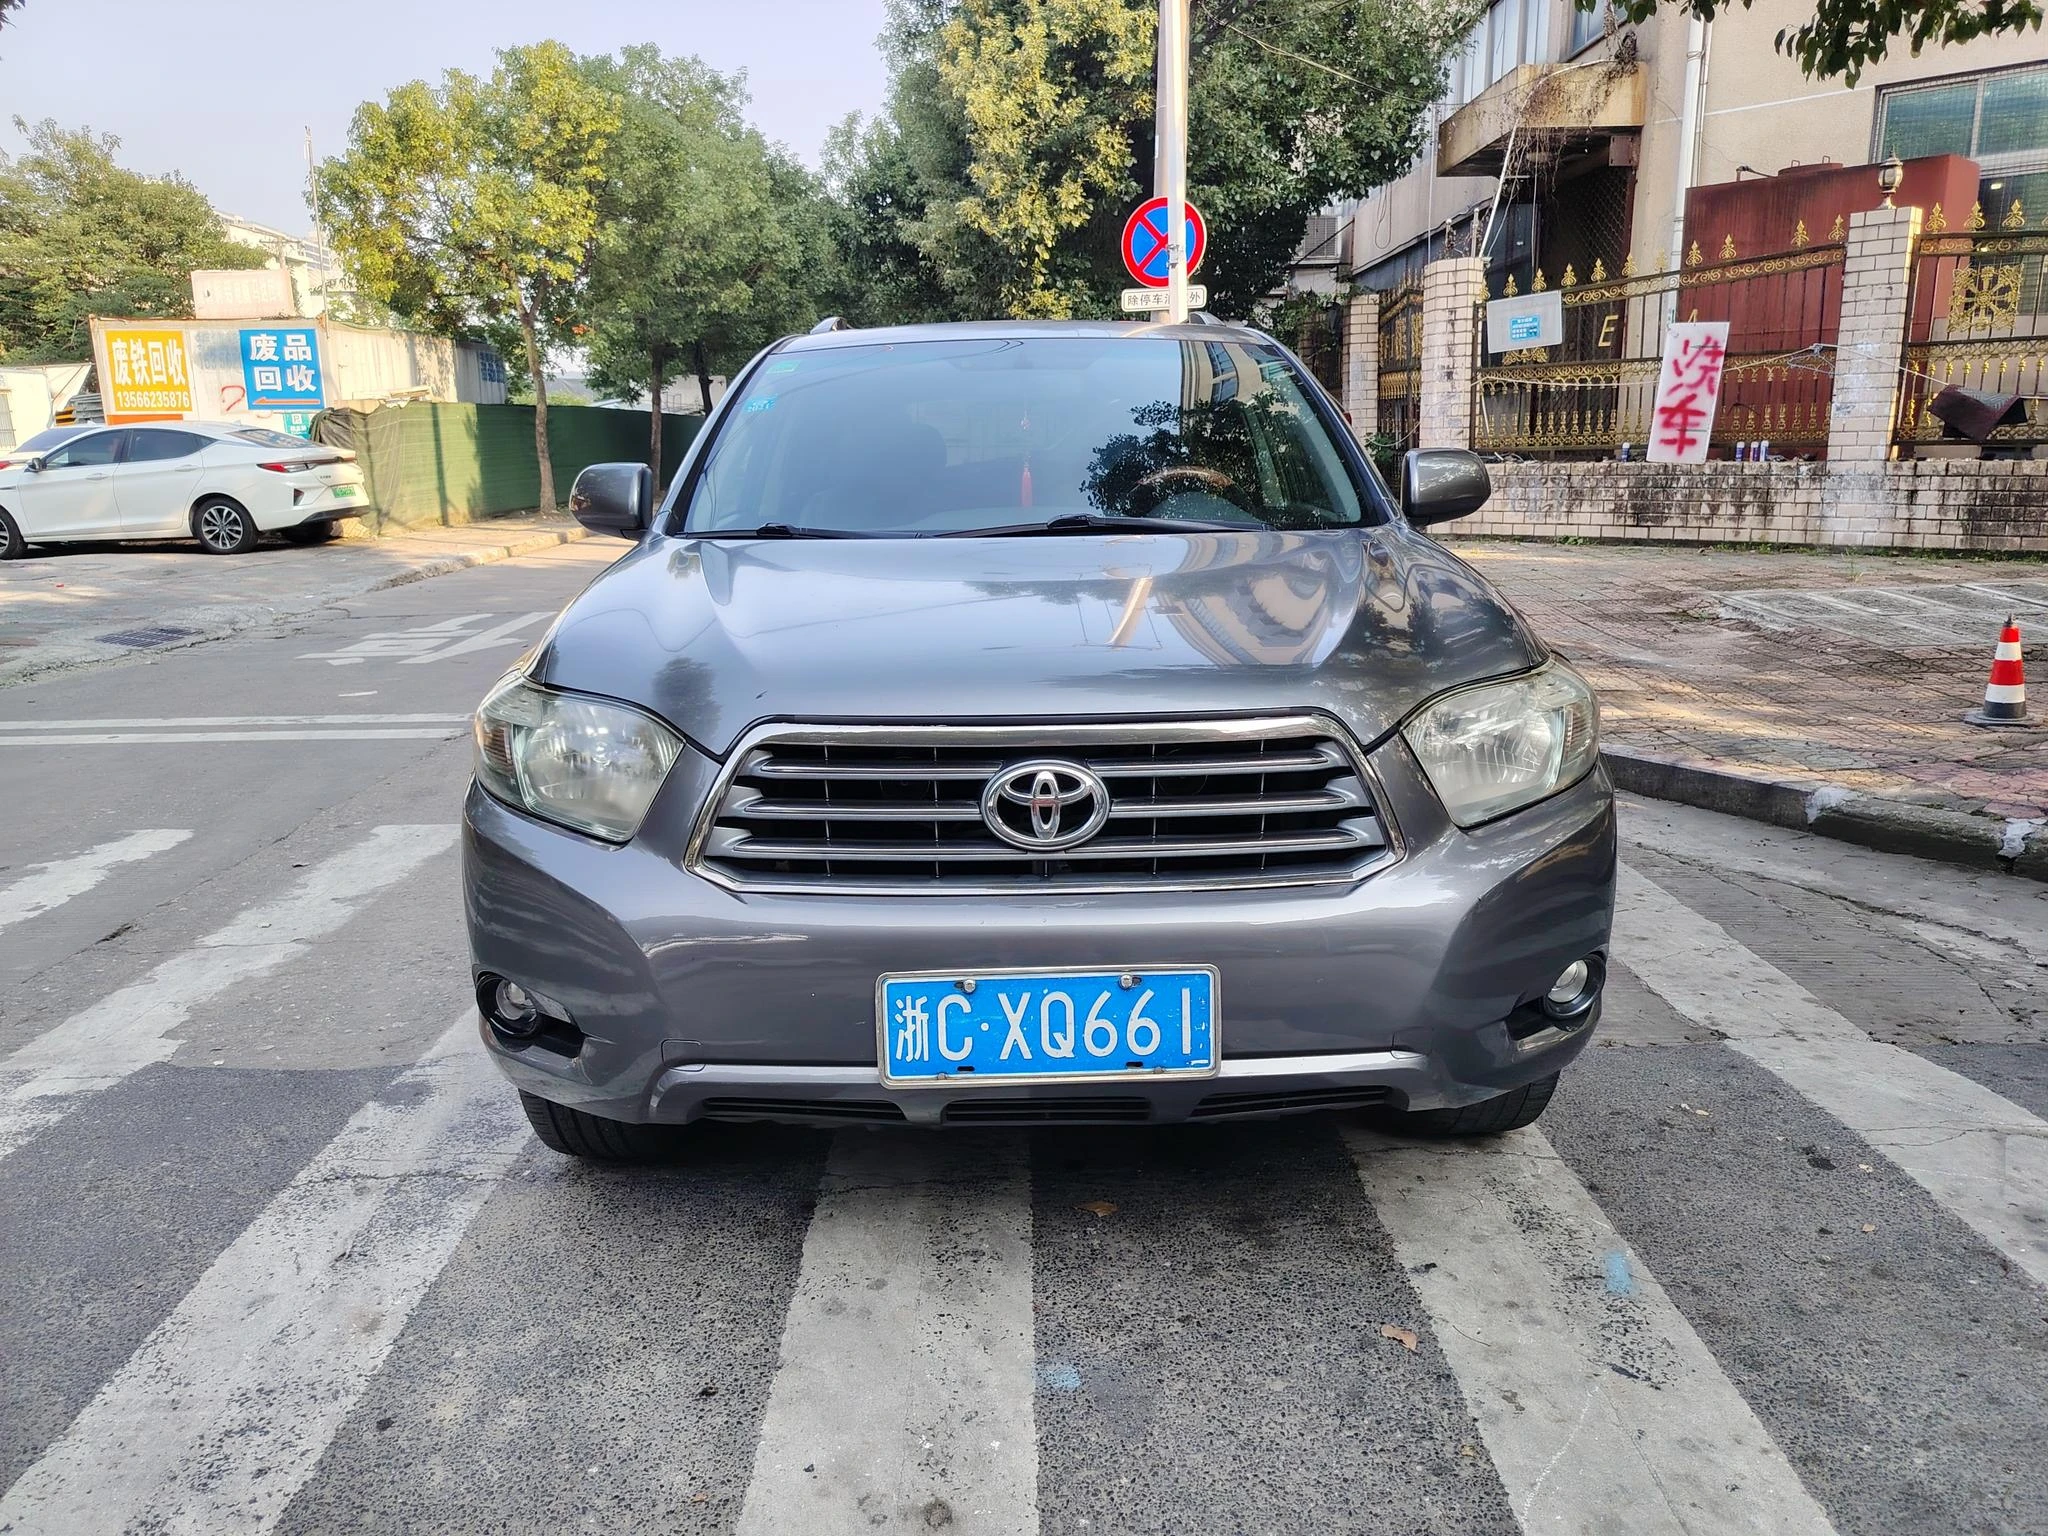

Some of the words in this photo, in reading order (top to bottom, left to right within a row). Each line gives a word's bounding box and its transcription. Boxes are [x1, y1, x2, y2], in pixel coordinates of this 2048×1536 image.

[112, 338, 186, 386] 废铁回收
[250, 333, 312, 362] 废品
[254, 364, 317, 392] 回收
[1658, 335, 1725, 456] 洗车
[116, 390, 190, 409] 13566235876
[895, 987, 1192, 1063] 浙C·XQ661
